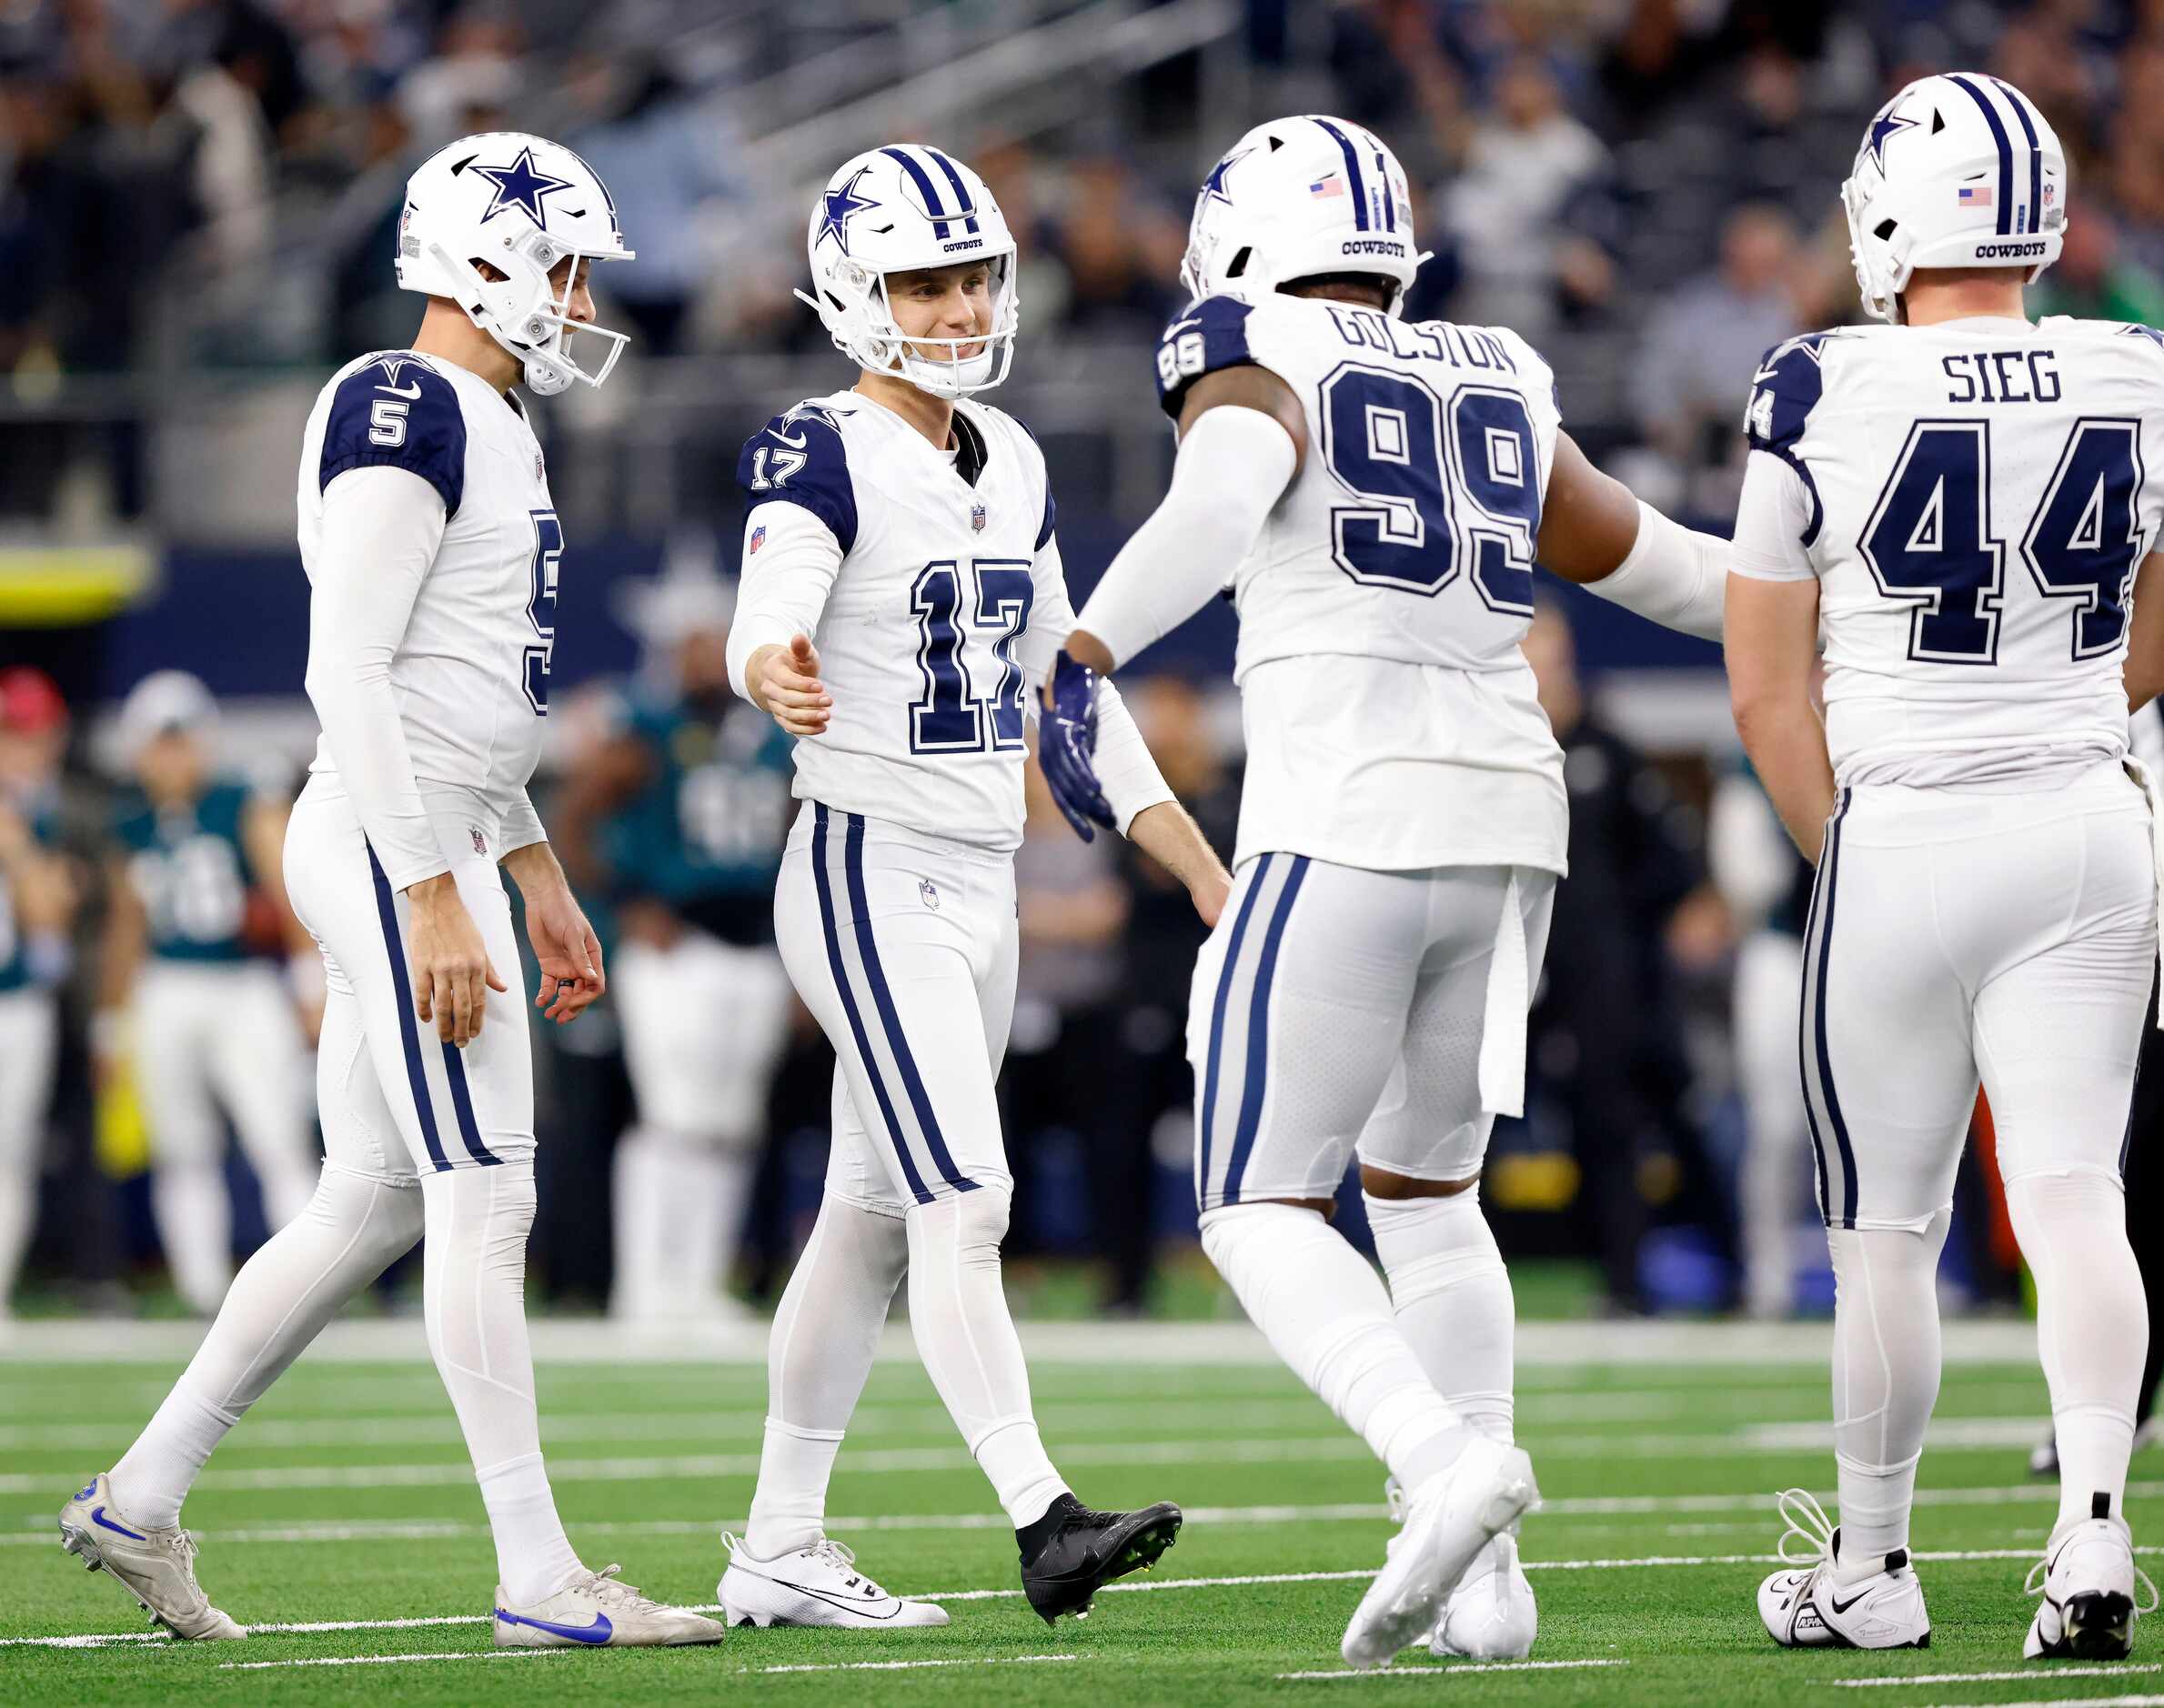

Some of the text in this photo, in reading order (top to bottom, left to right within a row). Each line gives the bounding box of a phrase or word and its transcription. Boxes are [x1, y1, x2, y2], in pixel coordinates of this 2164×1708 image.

[943, 238, 982, 253] COWBOYS
[1975, 242, 2046, 258] COWBOYS
[1324, 306, 1517, 375] GOLSTON
[1942, 350, 2061, 403] SIEG
[368, 400, 411, 447] 5
[751, 447, 808, 490] 17
[1318, 360, 1539, 618] 99
[1856, 417, 2145, 666] 44
[909, 558, 1034, 755] 17
